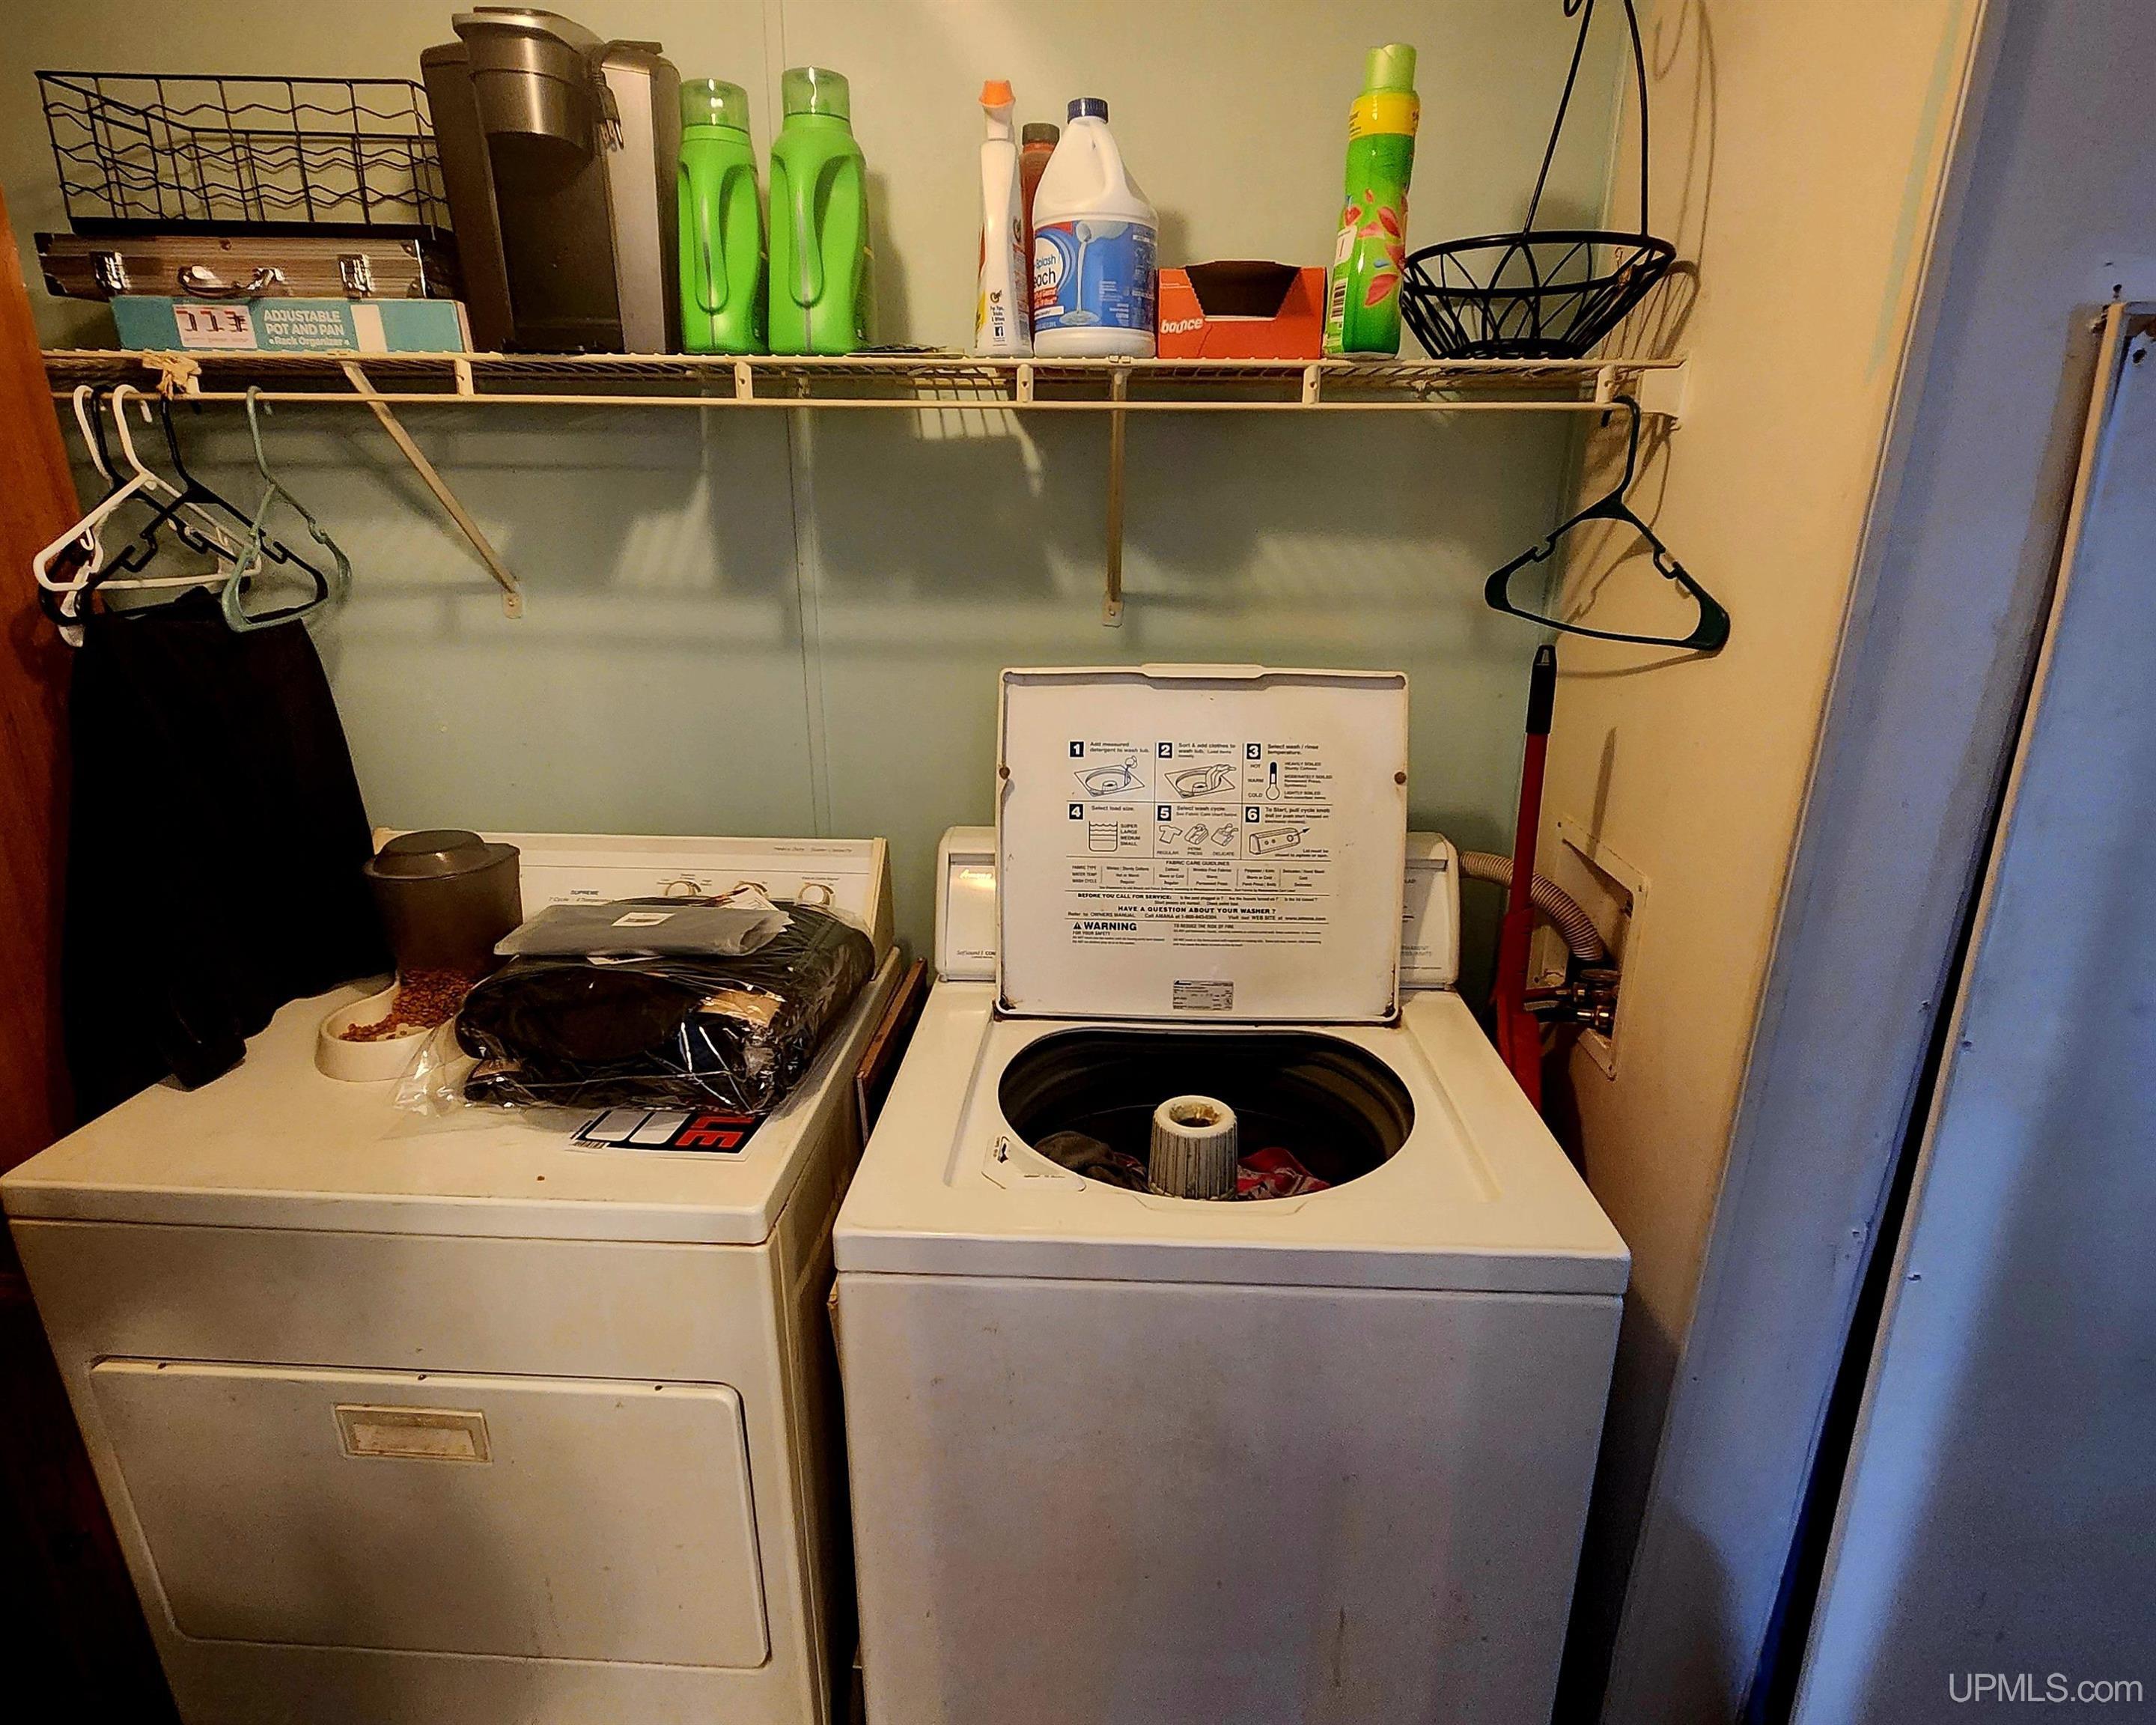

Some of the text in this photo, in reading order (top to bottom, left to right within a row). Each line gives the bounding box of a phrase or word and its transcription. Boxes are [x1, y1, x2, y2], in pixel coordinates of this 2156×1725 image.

[264, 309, 341, 323] ADJUSTABLE
[266, 323, 344, 336] POT AND PAN
[1160, 319, 1205, 334] bounce
[1084, 922, 1136, 931] WARNING
[674, 1116, 755, 1148] LE
